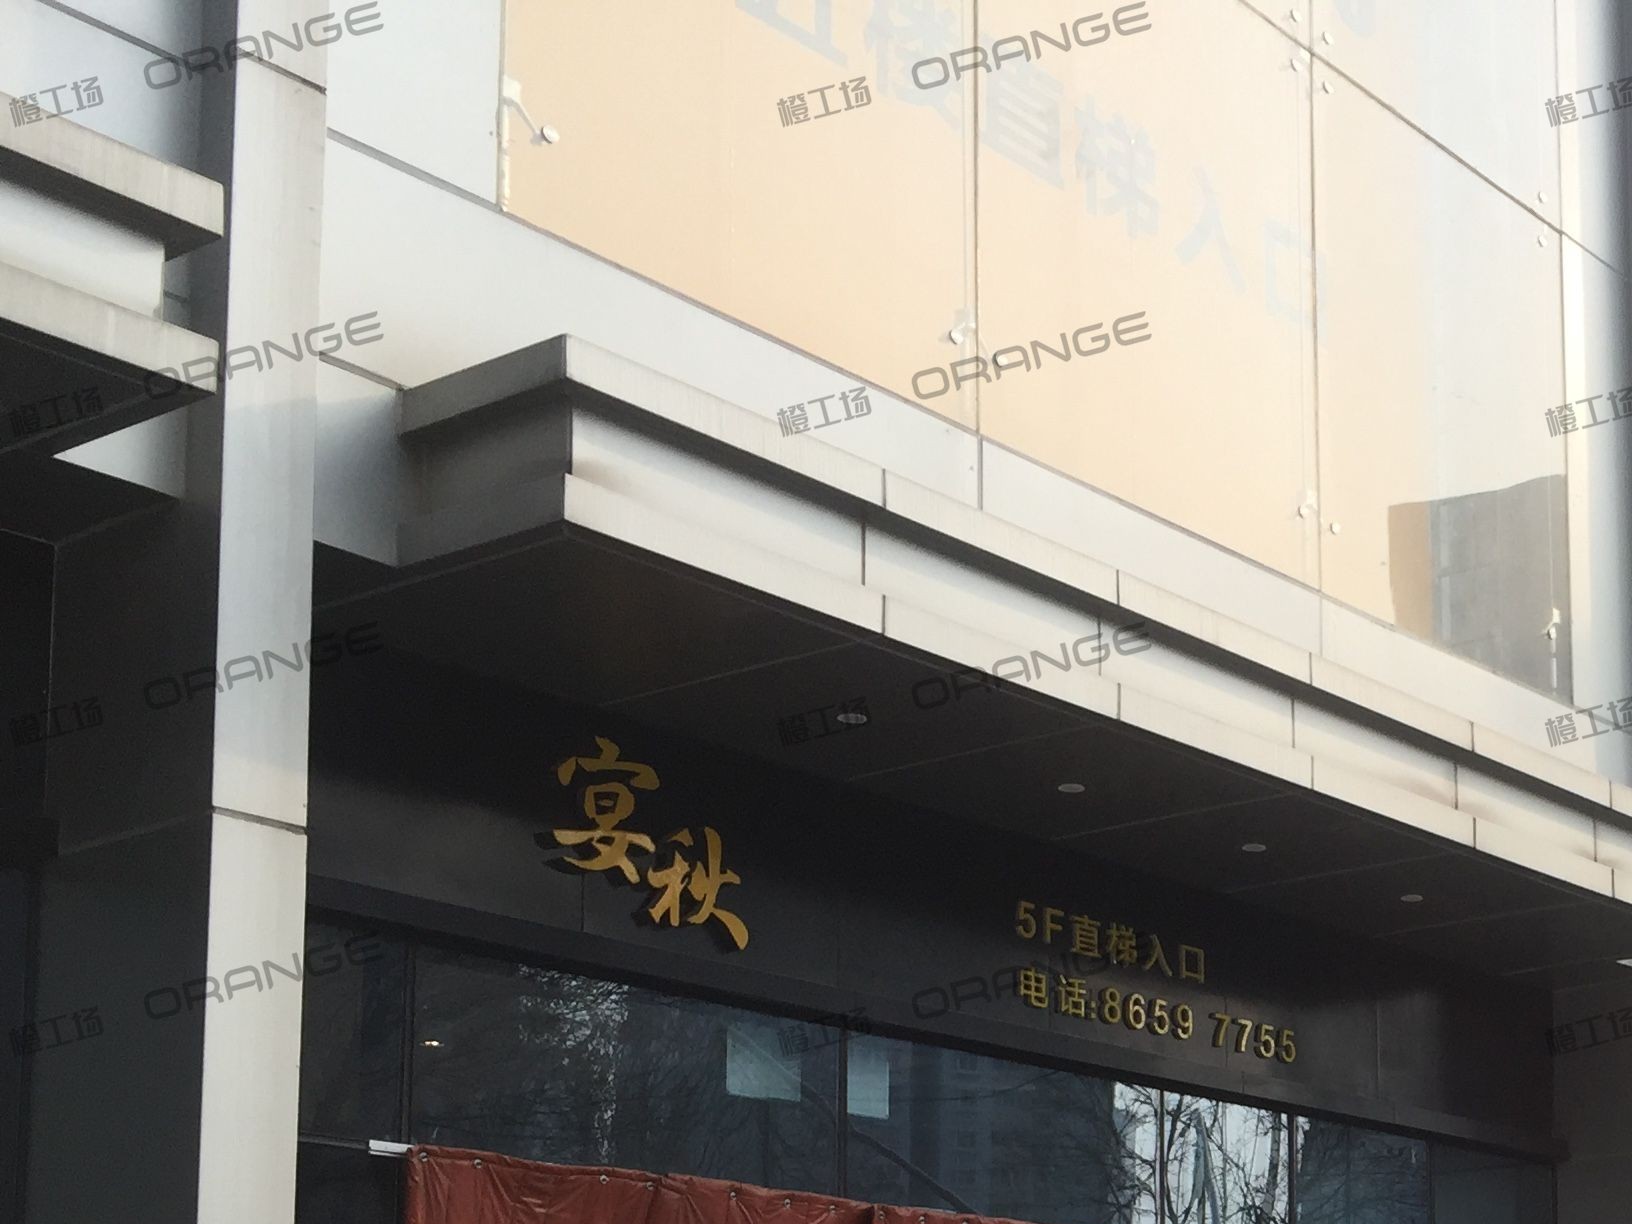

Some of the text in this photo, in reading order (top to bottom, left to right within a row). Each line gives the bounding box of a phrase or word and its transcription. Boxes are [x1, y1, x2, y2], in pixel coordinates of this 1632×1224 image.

[1015, 899, 1207, 985] 5F直梯入口
[1210, 1011, 1297, 1064] 7755
